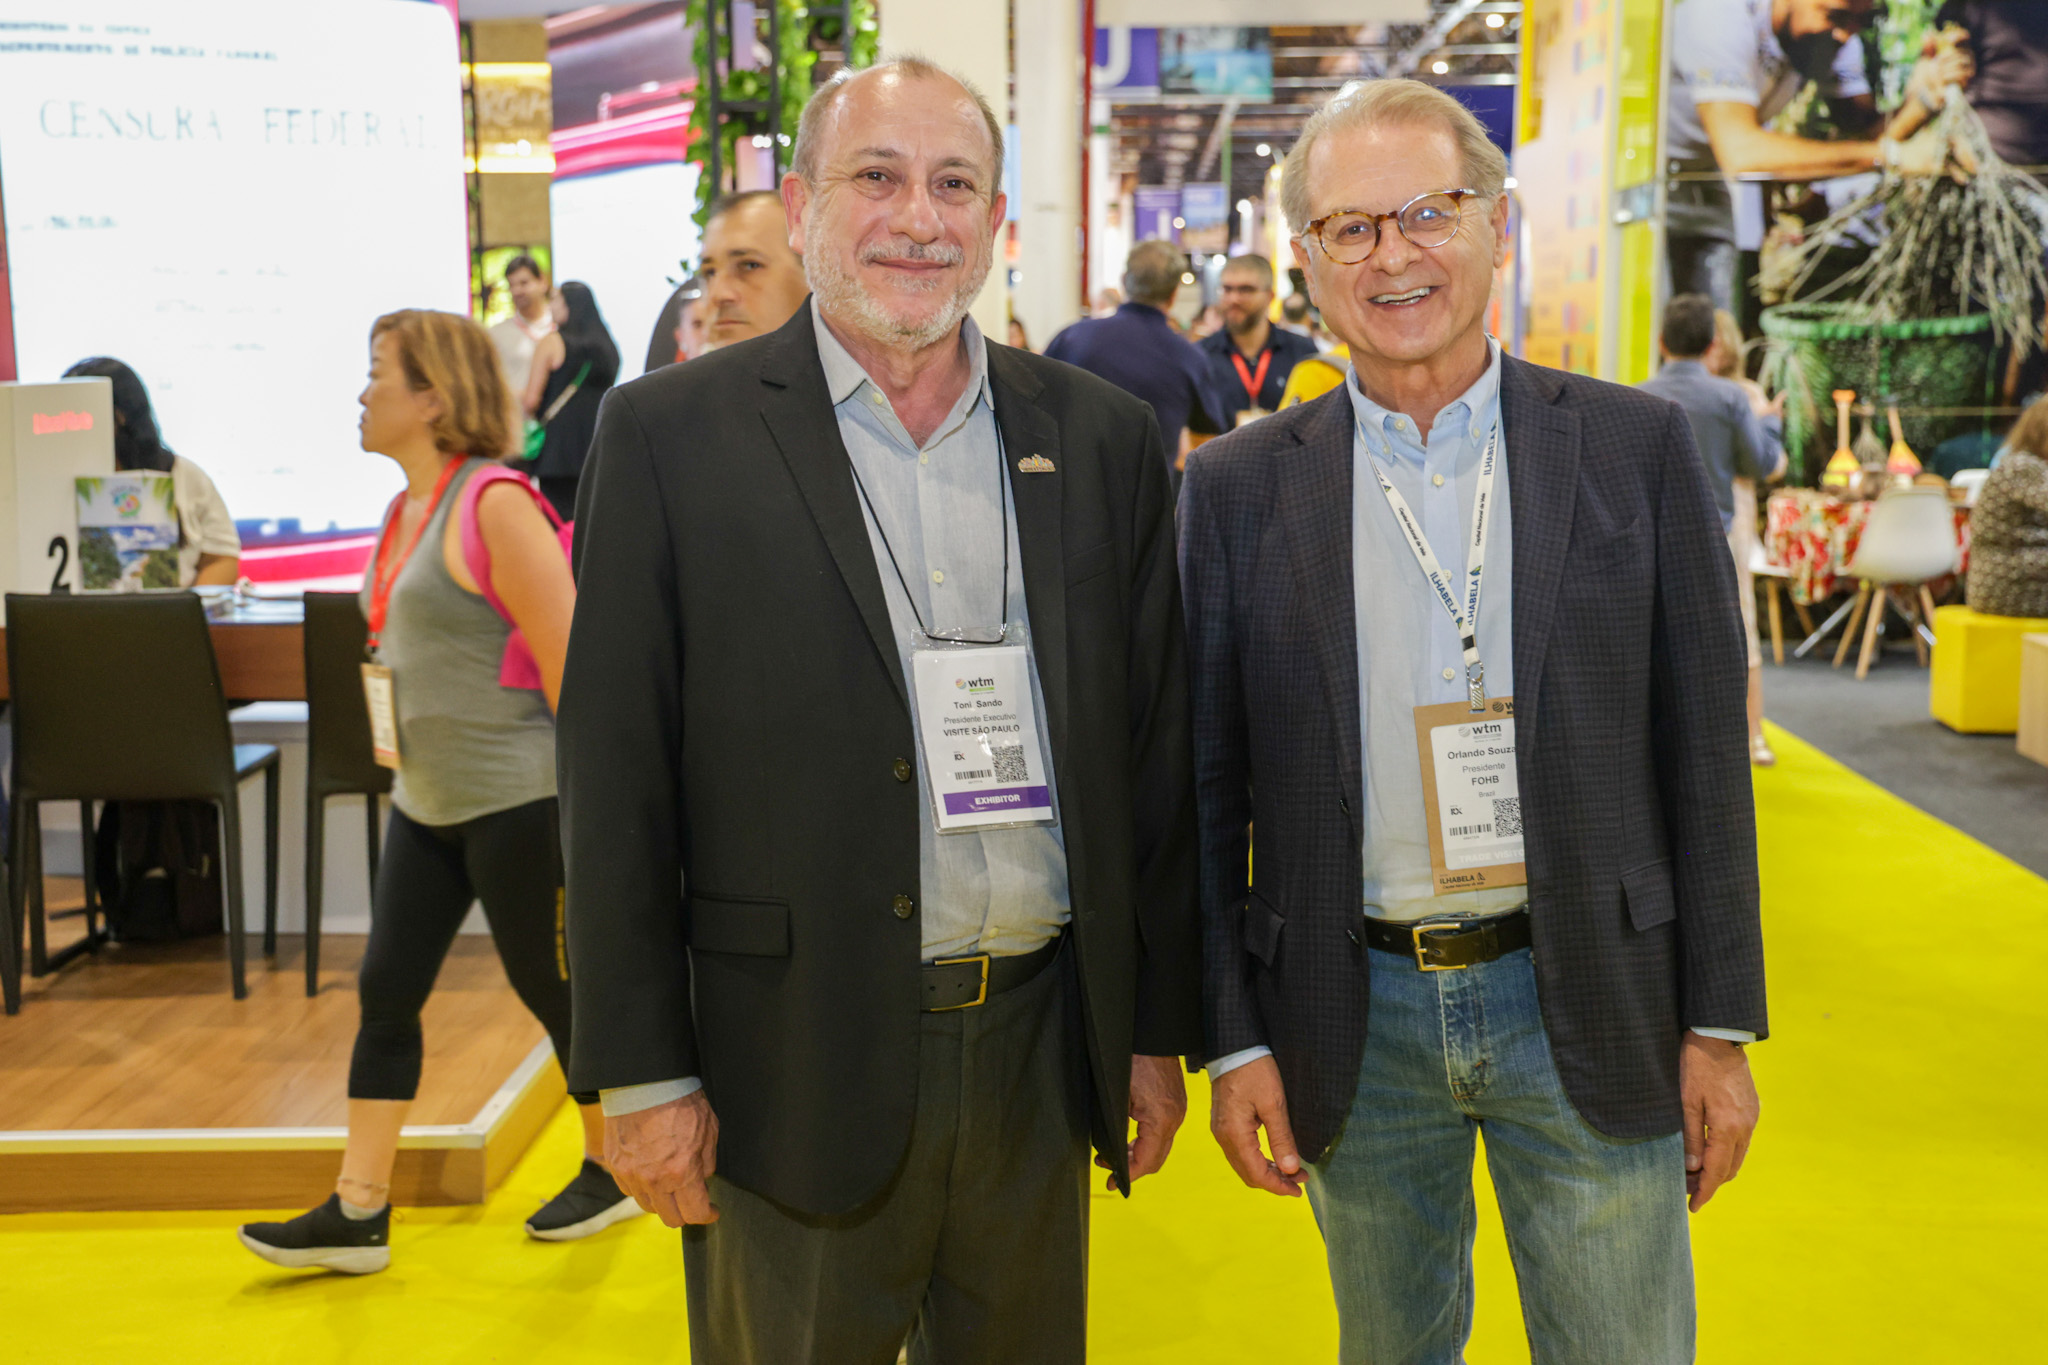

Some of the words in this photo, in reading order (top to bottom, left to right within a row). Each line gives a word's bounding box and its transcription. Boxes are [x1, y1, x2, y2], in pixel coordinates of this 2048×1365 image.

[39, 98, 223, 142] CENSURA
[263, 107, 438, 149] FEDERAL
[1482, 432, 1496, 476] ILHABELA
[48, 536, 71, 594] 2
[1429, 571, 1458, 617] ILHABELA
[967, 677, 995, 688] wtm
[953, 701, 972, 710] Toni
[976, 699, 1003, 708] Sando
[944, 716, 981, 724] Presidente
[983, 713, 1017, 722] Executivo
[943, 727, 970, 737] VISITE
[972, 725, 990, 735] SÃO
[991, 724, 1020, 733] PAULO
[1472, 723, 1502, 735] wtm
[1447, 749, 1486, 760] Orlando
[1487, 746, 1516, 756] Souza
[1462, 762, 1506, 773] Presidente
[1471, 775, 1500, 786] FOHB
[974, 794, 1021, 805] EXHIBITOR
[1478, 790, 1496, 798] Brazil
[1459, 852, 1492, 864] TRADE
[1494, 848, 1524, 859] VISITO
[1440, 875, 1475, 885] ILHABELA
